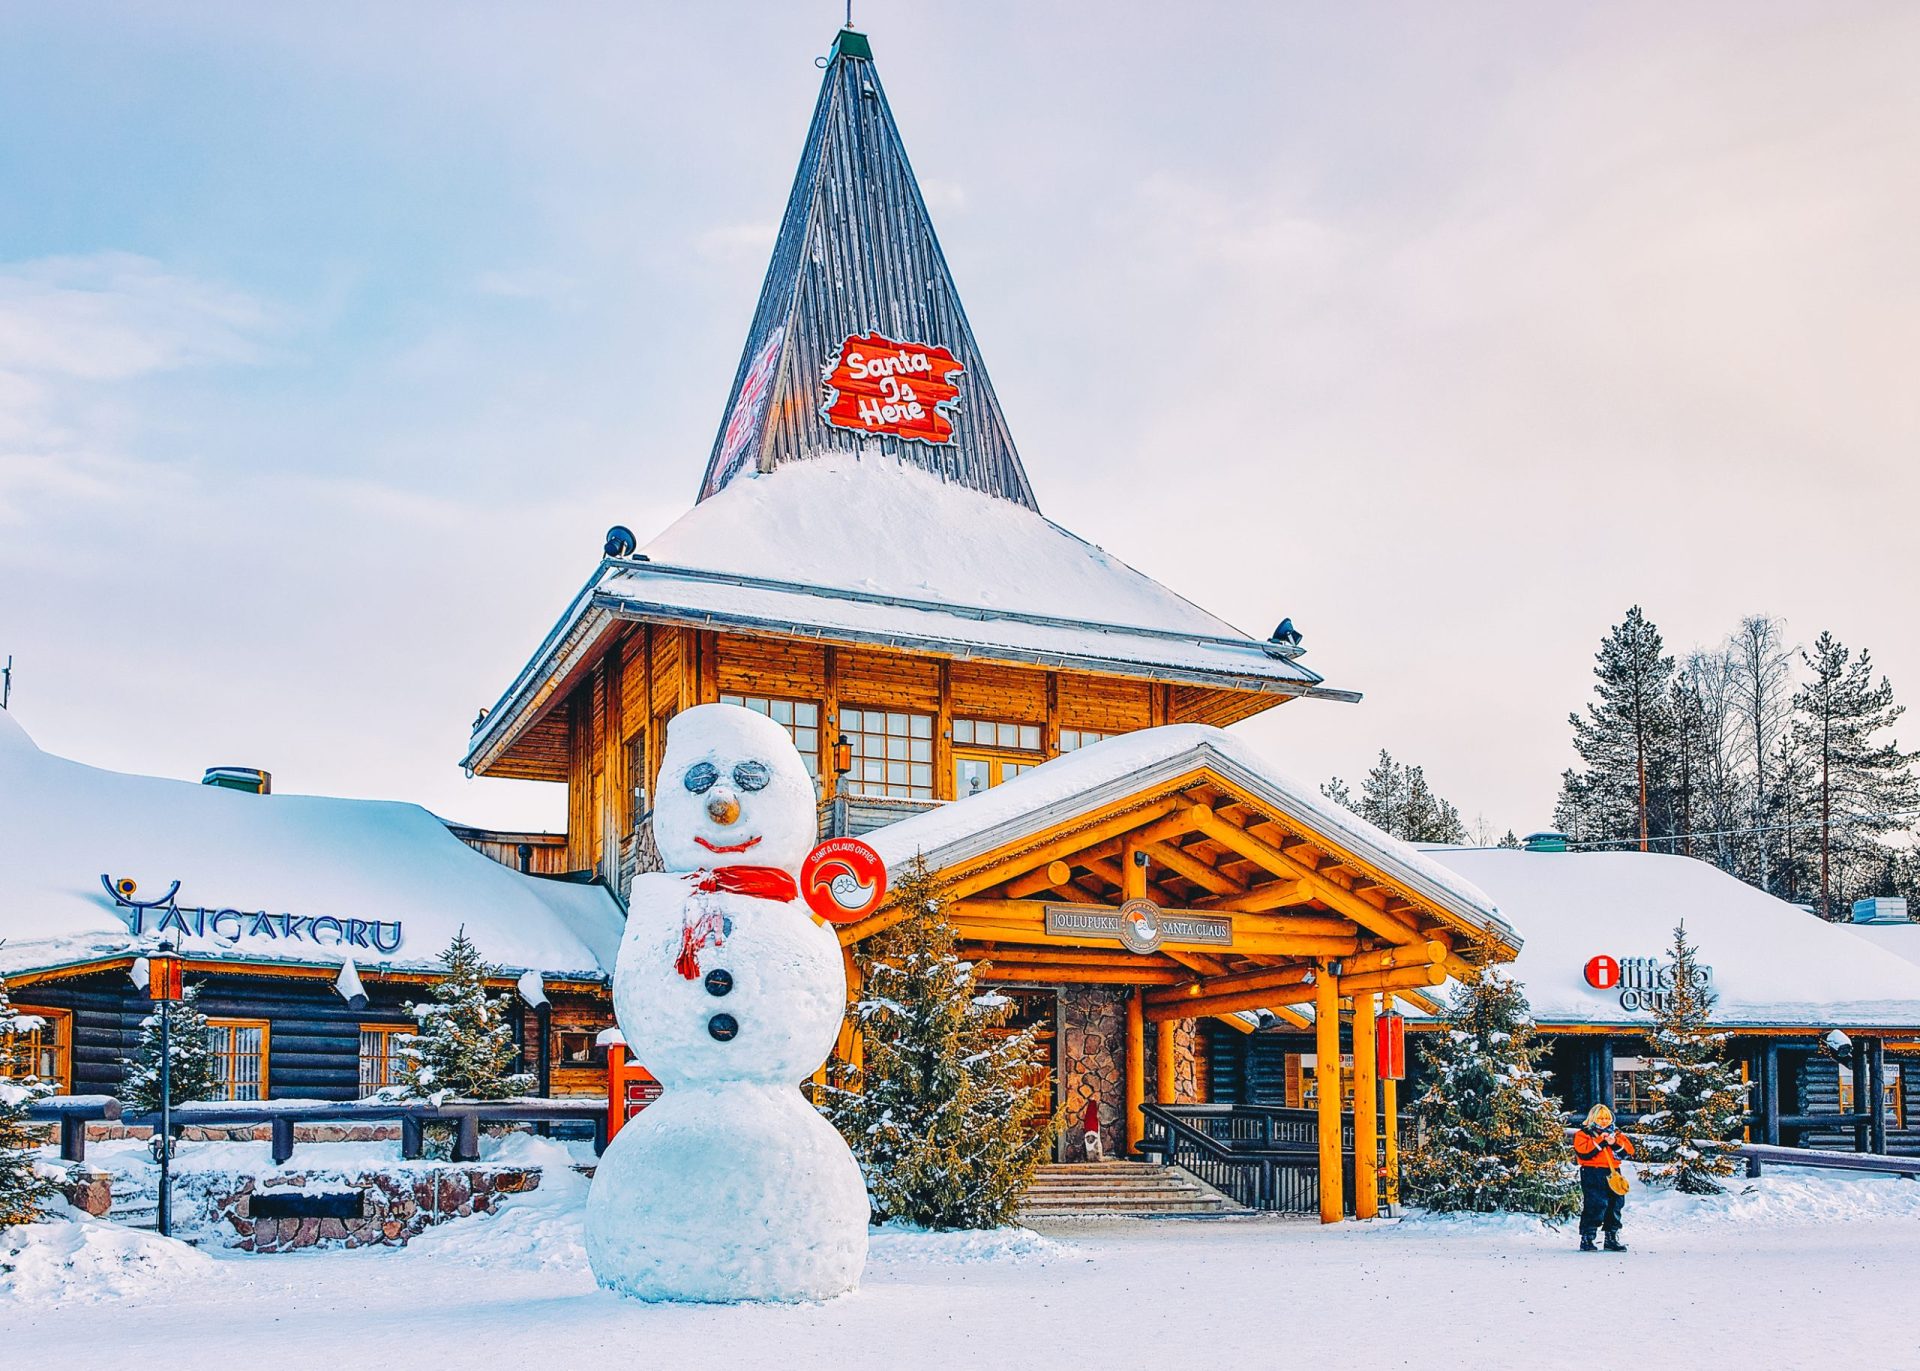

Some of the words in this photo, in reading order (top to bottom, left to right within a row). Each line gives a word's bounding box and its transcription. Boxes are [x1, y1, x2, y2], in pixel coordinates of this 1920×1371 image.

[847, 350, 932, 379] Santa
[879, 376, 917, 403] Is
[858, 399, 925, 426] Here
[811, 846, 832, 863] SANTA
[832, 843, 855, 852] CLAUS
[855, 846, 877, 864] OFFICE
[100, 873, 402, 952] TAIGAKORU
[1053, 914, 1120, 930] JOULUPUKKI
[1162, 921, 1194, 935] SANTA
[1195, 924, 1227, 937] CLAUS
[1620, 957, 1712, 988] iittaa
